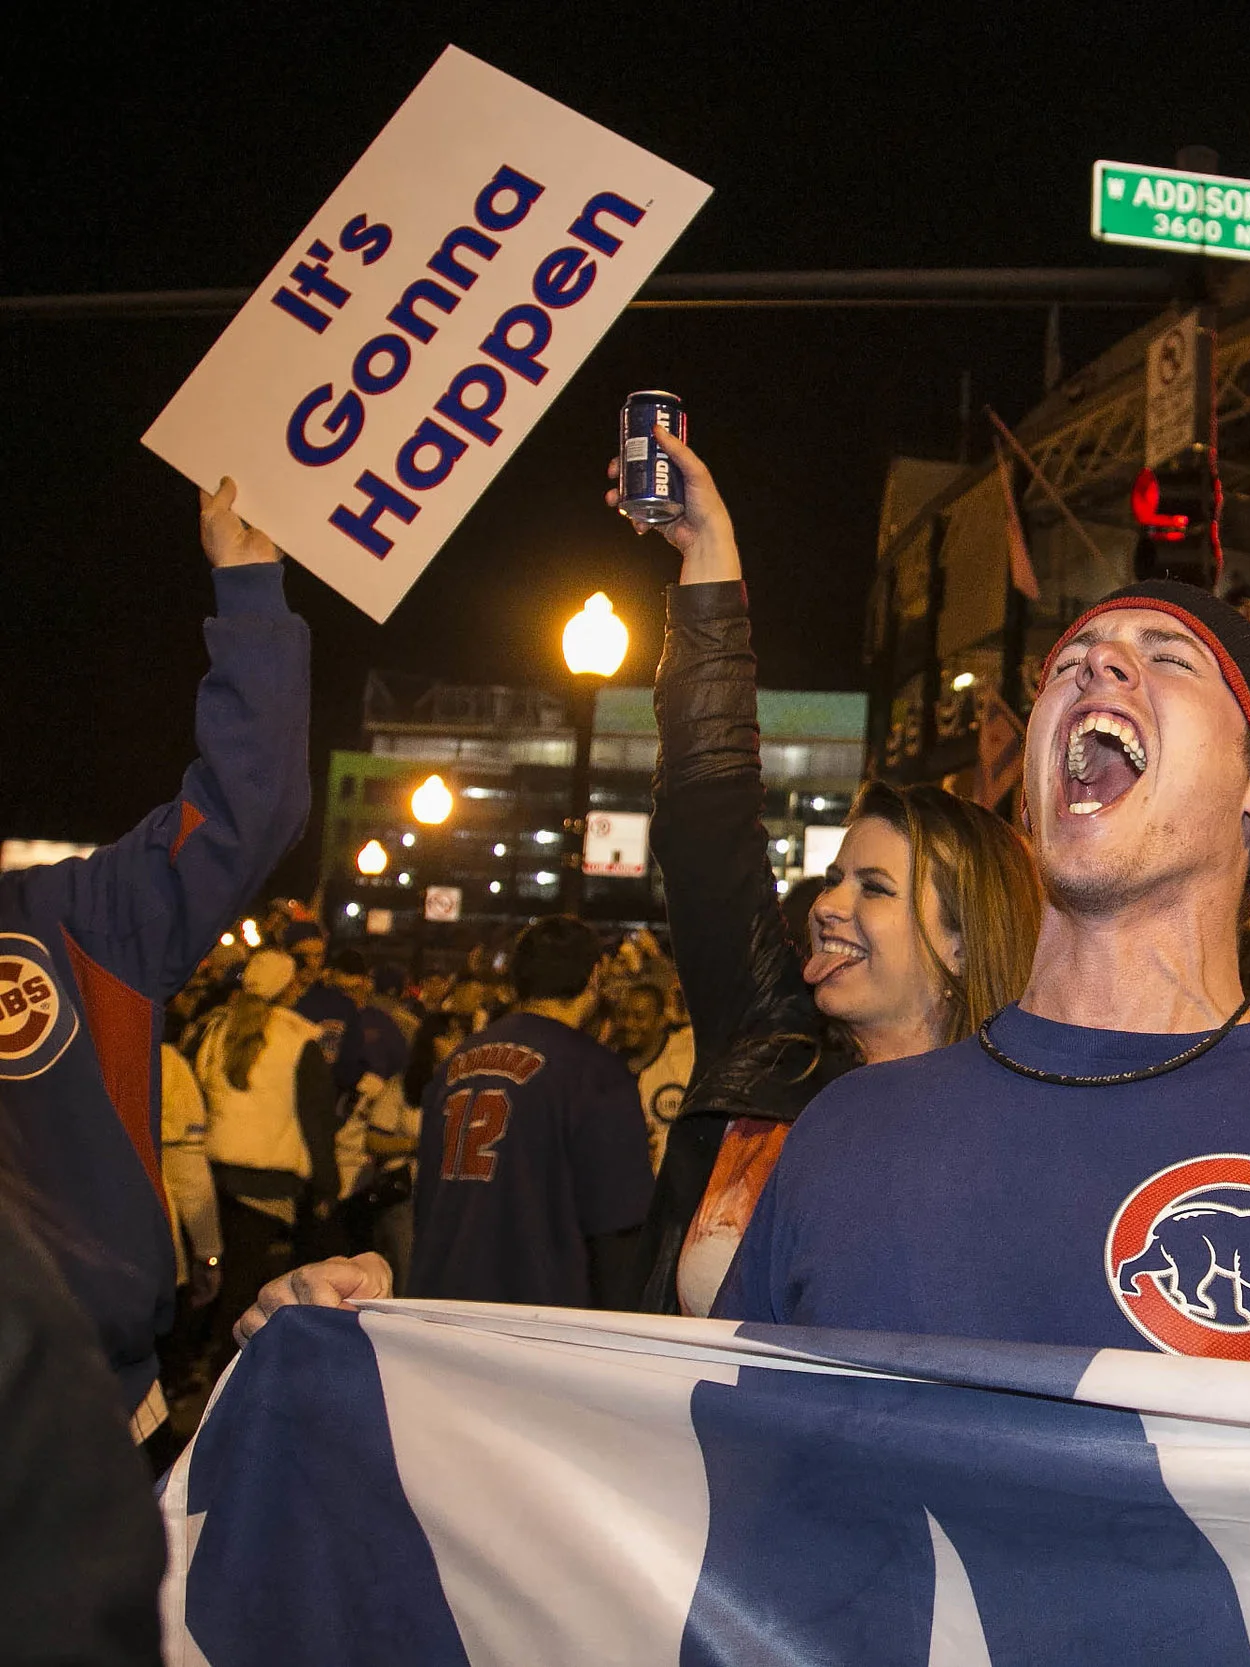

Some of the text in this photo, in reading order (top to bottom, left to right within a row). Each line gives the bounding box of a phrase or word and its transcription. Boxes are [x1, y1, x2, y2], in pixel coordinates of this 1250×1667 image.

[1107, 177, 1126, 200] W
[1153, 213, 1223, 243] 3600
[271, 212, 394, 335] It's
[286, 164, 546, 467] Gonna
[327, 190, 647, 560] Happen
[656, 460, 669, 496] BUD
[441, 1088, 513, 1182] 12
